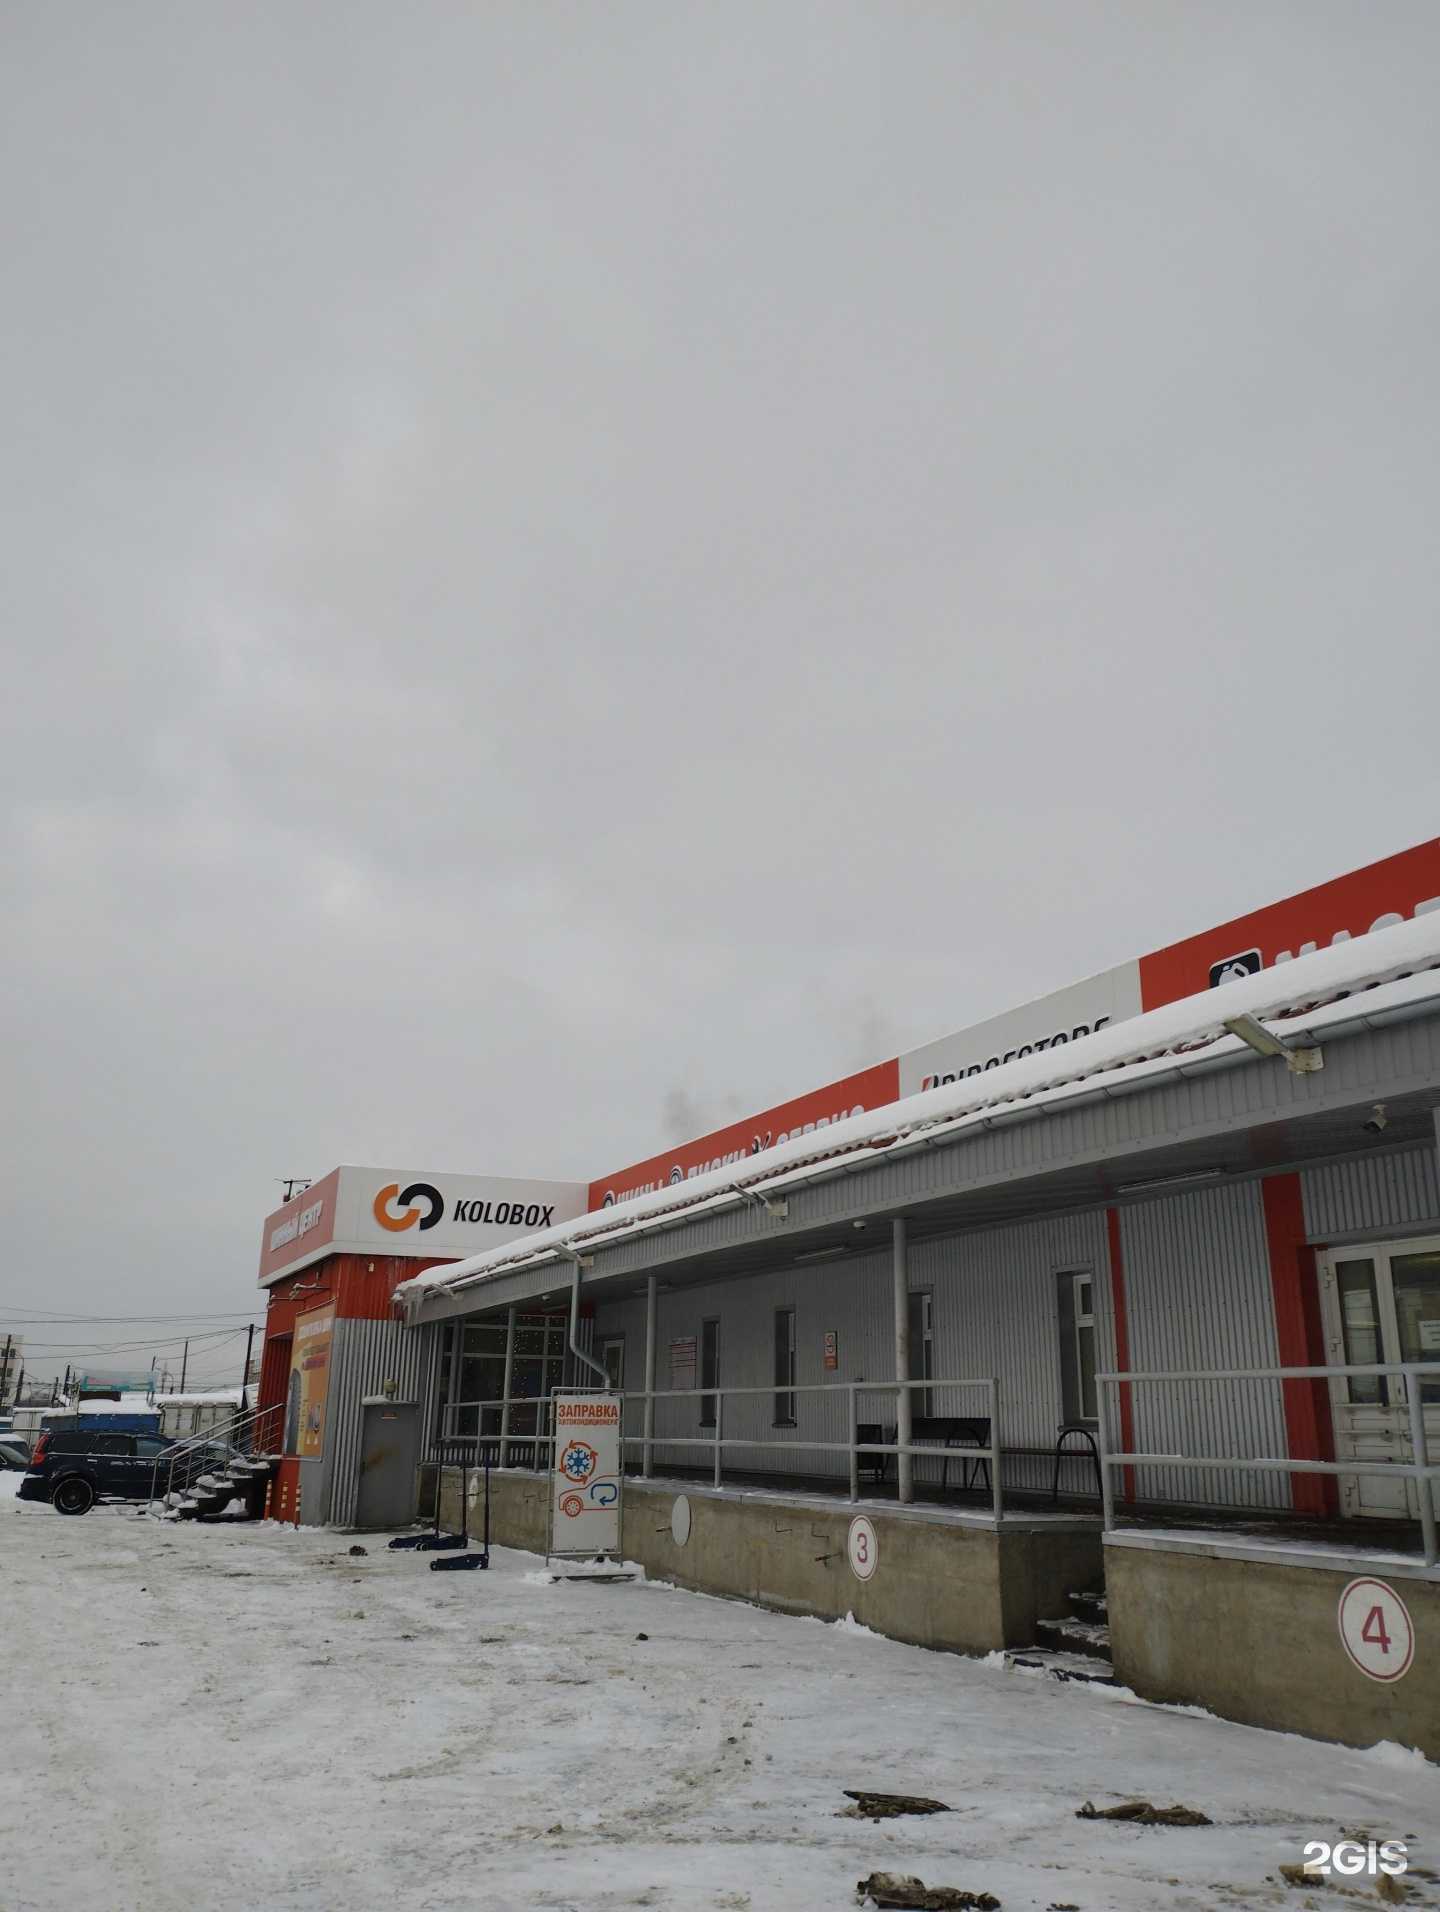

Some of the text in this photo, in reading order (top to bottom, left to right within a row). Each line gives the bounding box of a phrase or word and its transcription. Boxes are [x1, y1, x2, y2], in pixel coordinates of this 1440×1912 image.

[453, 1199, 554, 1227] KOLOBOX
[558, 1404, 618, 1418] ЗАПРАВКА
[856, 1532, 868, 1563] 3
[1361, 1605, 1392, 1655] 4
